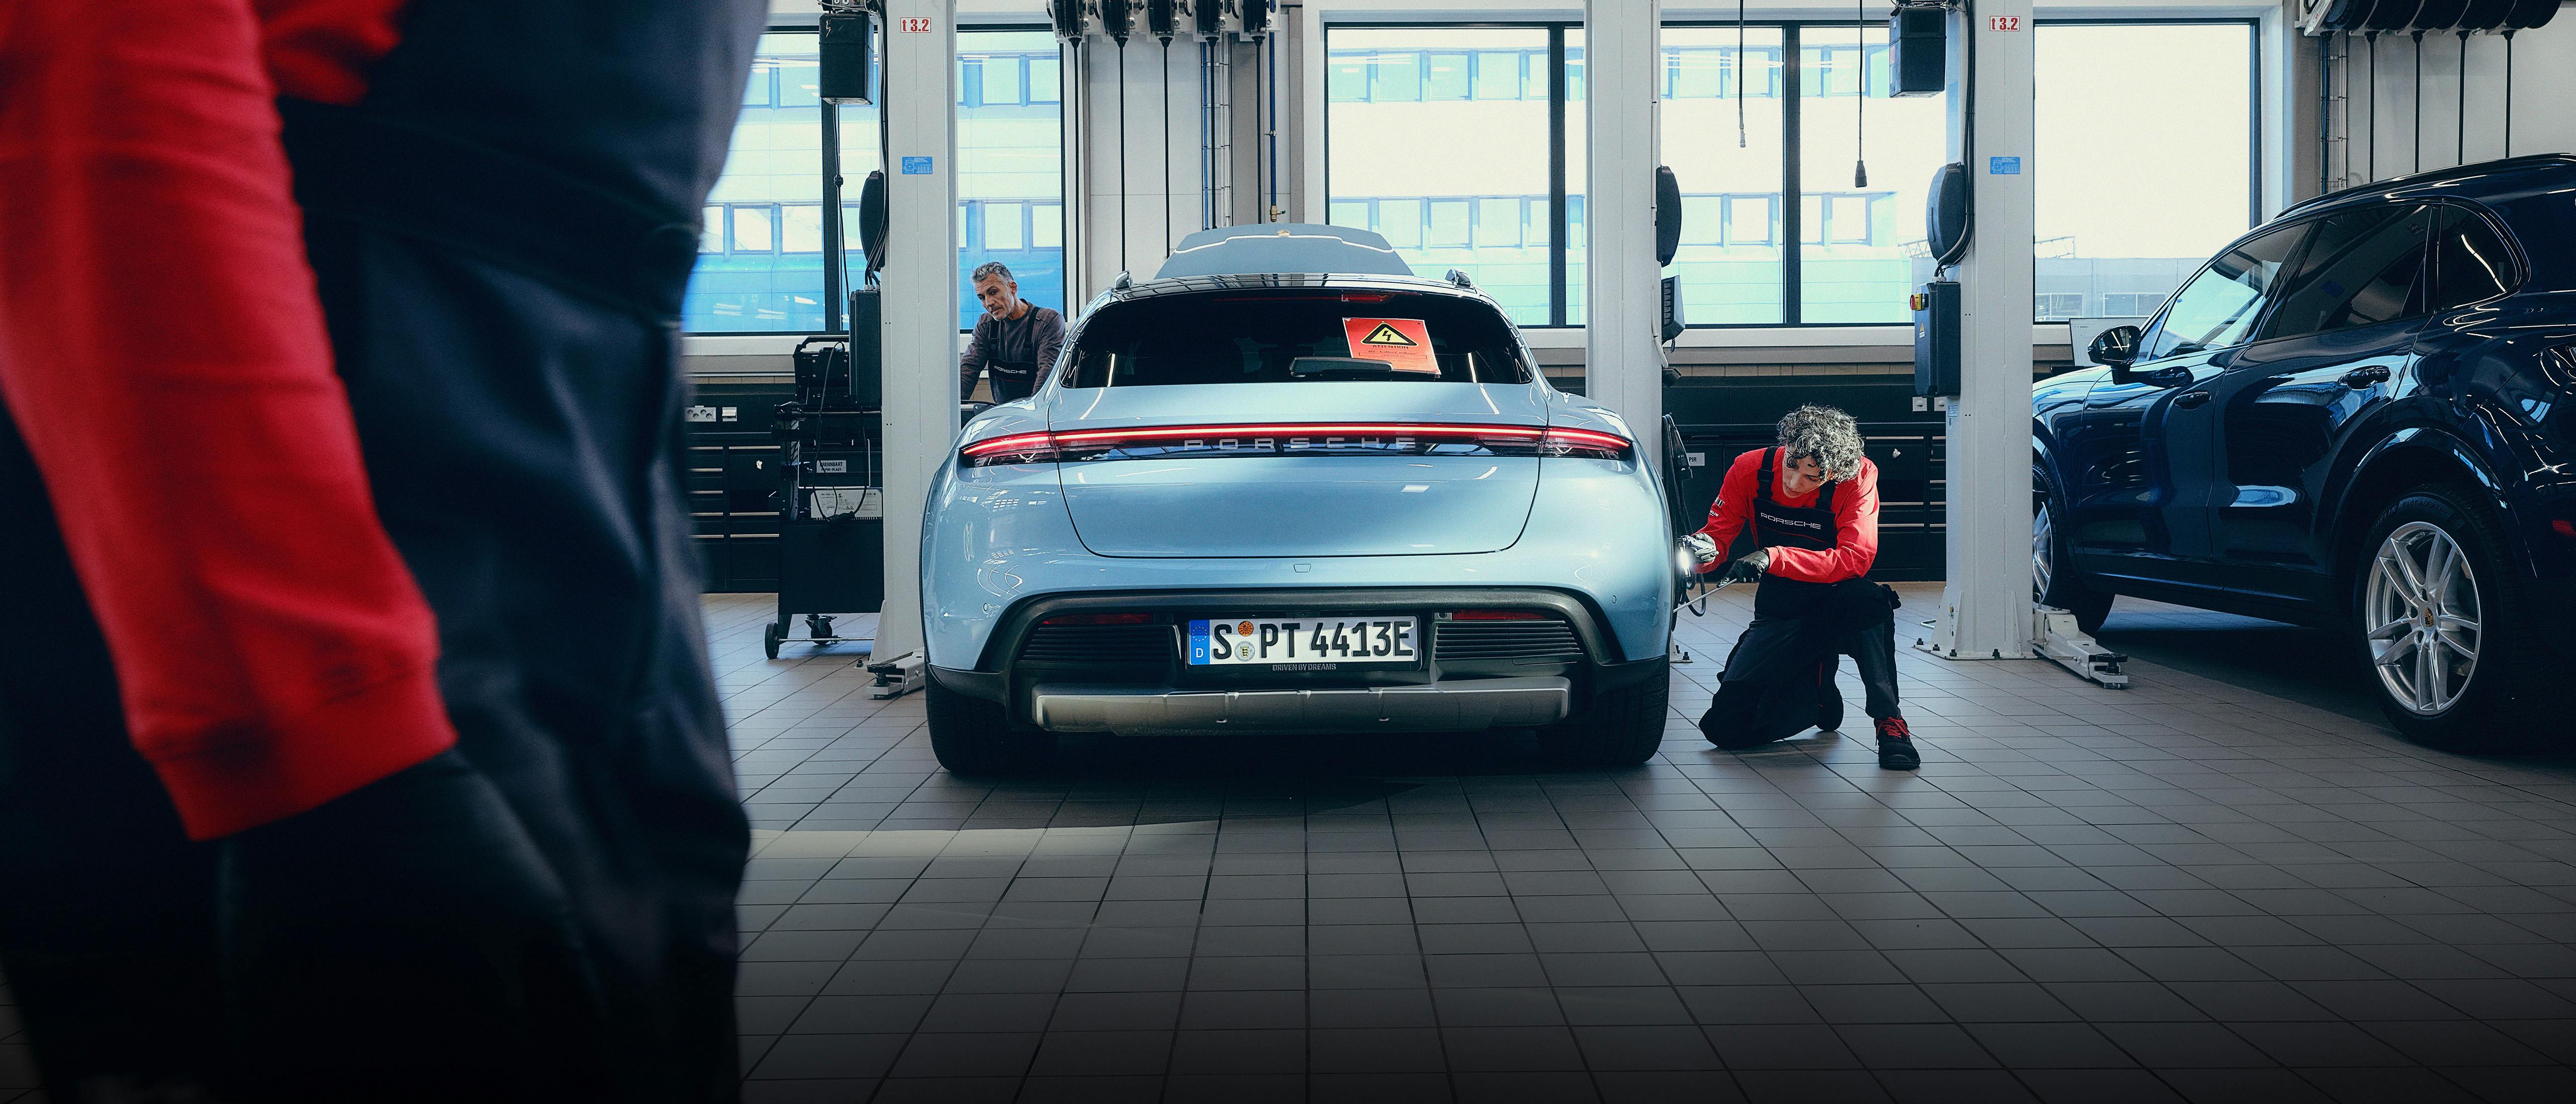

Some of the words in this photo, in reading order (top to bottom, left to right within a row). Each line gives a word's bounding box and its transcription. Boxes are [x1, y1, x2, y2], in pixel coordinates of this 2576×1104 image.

[902, 20, 907, 31] t
[910, 19, 929, 32] 3.2
[1991, 18, 1996, 30] t
[1999, 17, 2018, 30] 3.2
[994, 365, 1027, 374] PORSCHE
[1184, 437, 1416, 451] PORSCHE
[1760, 512, 1821, 530] PORSCHE
[1213, 623, 1232, 660] S
[1259, 622, 1301, 659] PT
[1310, 621, 1414, 657] 4413E
[1196, 648, 1204, 658] D
